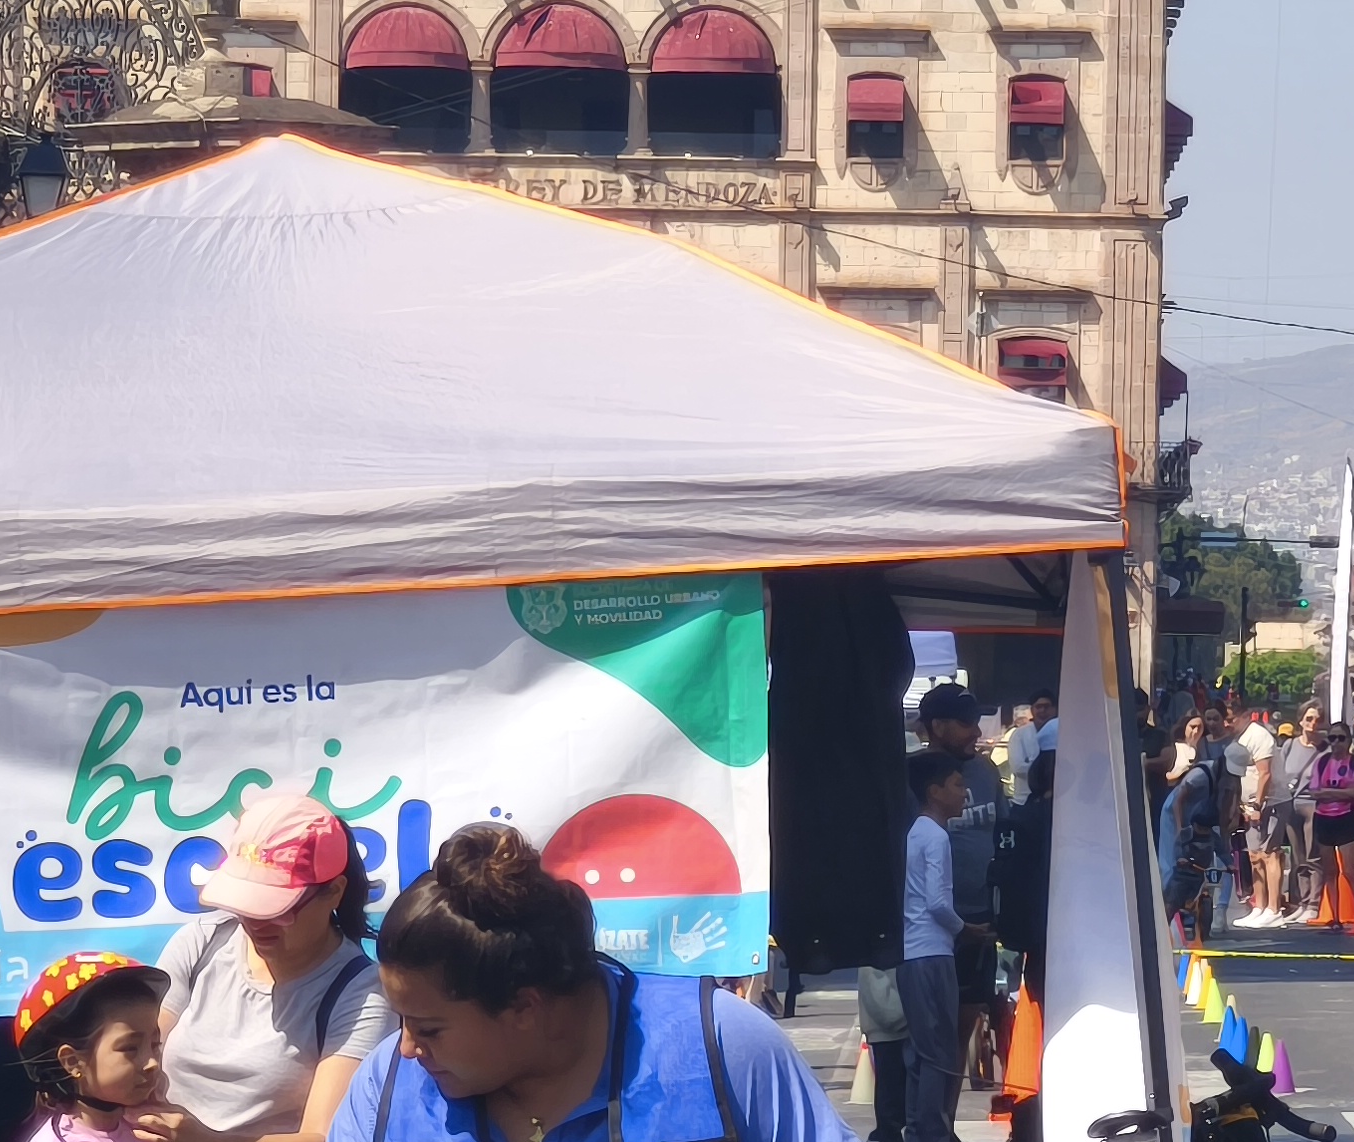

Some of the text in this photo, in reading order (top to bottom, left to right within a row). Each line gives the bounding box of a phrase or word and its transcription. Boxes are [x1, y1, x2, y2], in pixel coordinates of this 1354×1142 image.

[581, 179, 623, 206] DE
[573, 595, 661, 611] DESARROLLO
[574, 609, 663, 626] Y MOVILIDAD
[262, 683, 298, 703] es
[306, 674, 335, 701] la
